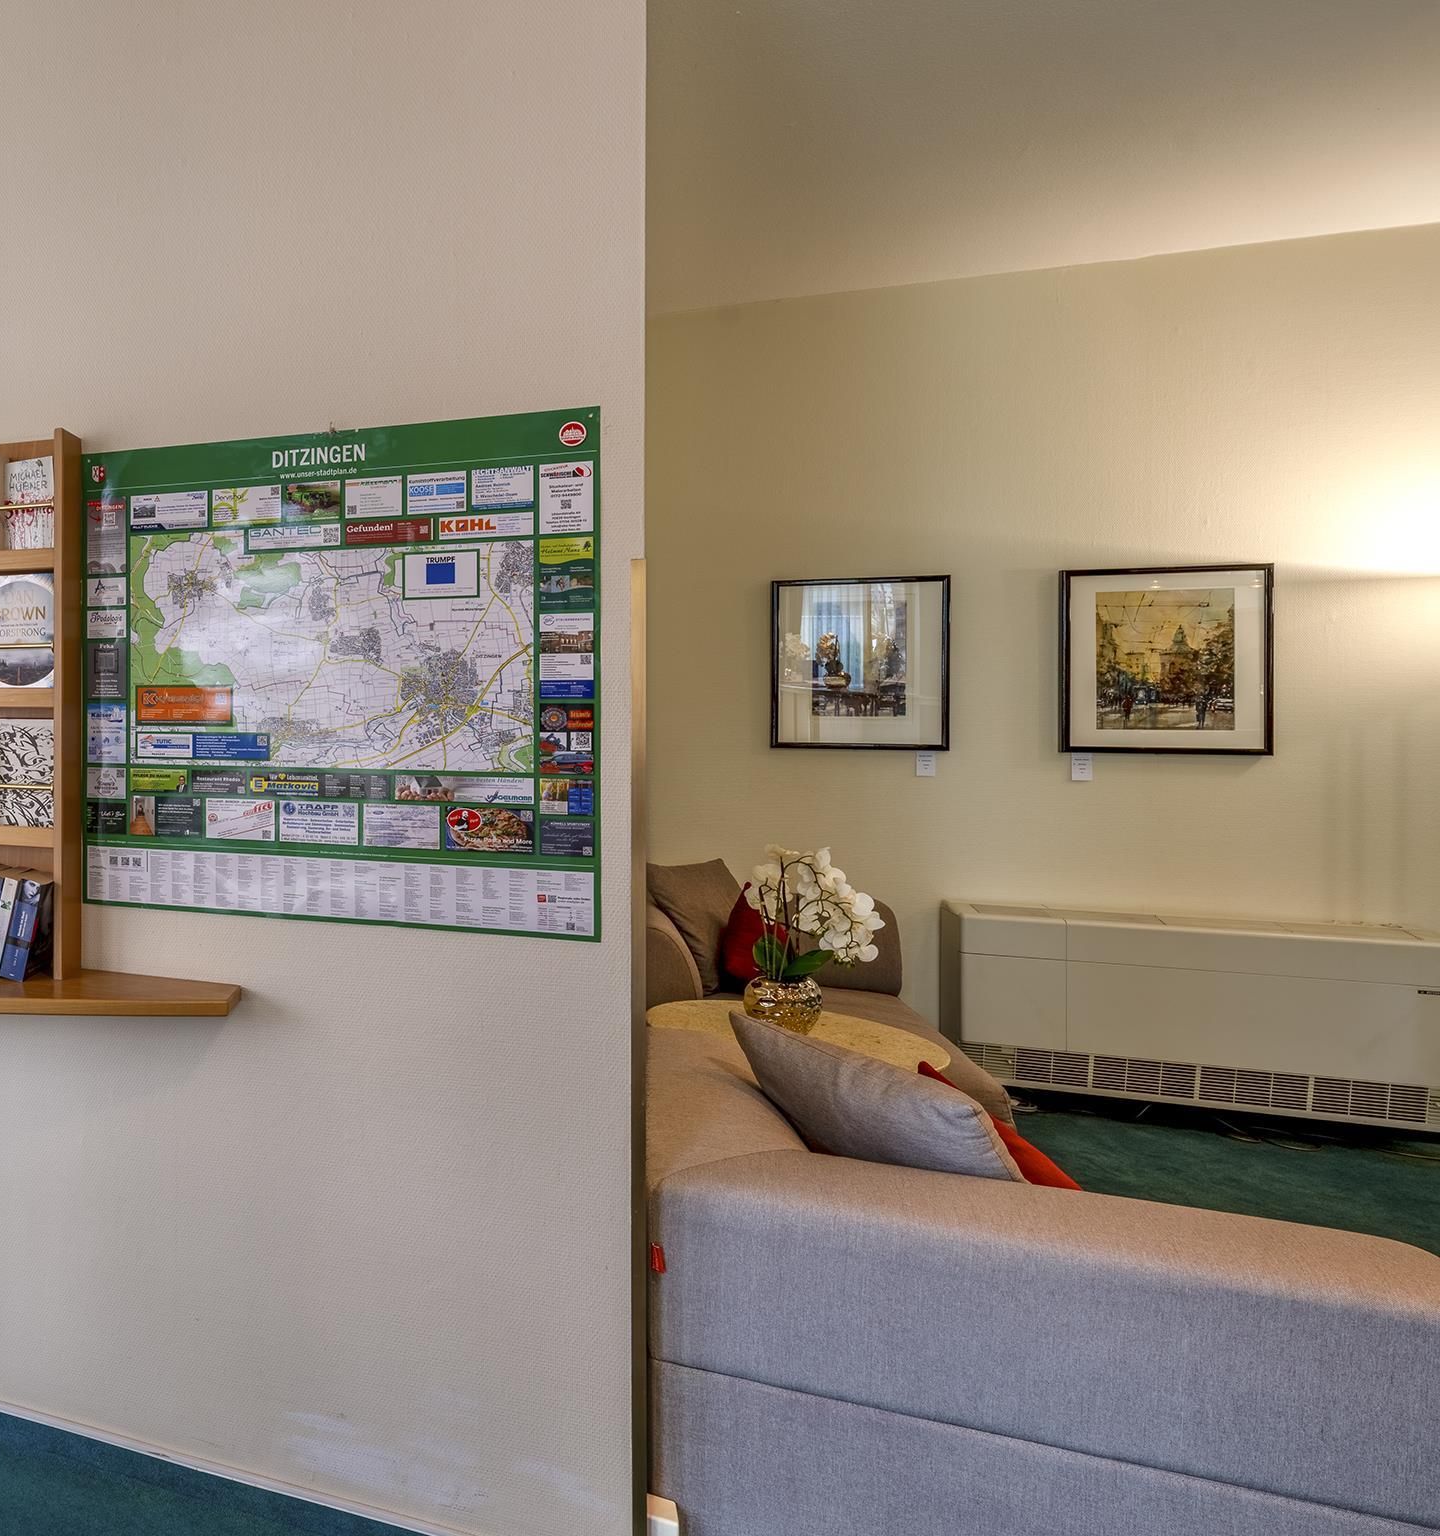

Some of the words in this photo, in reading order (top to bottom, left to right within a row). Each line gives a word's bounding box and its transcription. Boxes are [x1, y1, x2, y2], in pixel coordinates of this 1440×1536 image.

[272, 444, 366, 469] DITZINGEN
[10, 469, 47, 481] MICHAEL
[280, 467, 357, 480] www.unser-stadtplan.de
[409, 485, 434, 494] KOOSE
[346, 523, 393, 533] Gefunden!
[426, 556, 456, 564] TRUMPF
